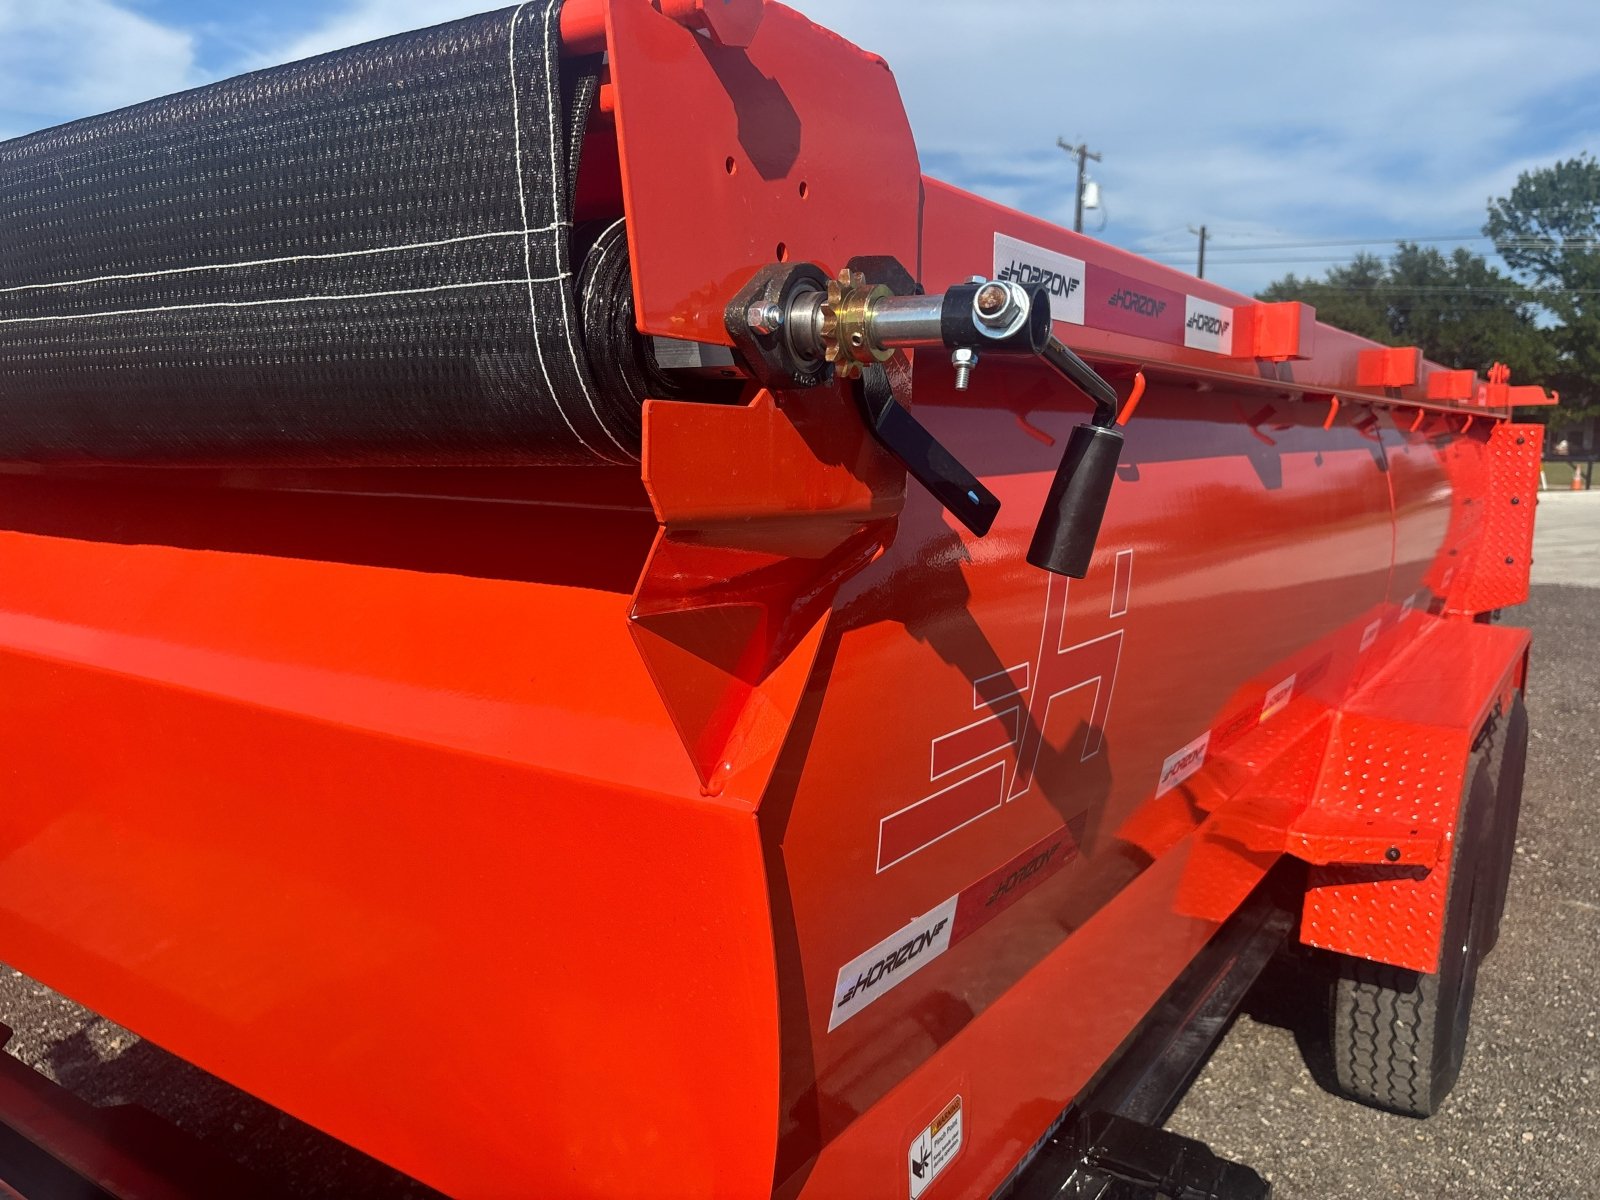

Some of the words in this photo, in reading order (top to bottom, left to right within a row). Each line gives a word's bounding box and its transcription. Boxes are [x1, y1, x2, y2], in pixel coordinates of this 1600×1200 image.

[1113, 288, 1162, 318] HORIZON
[1190, 312, 1226, 336] HORIZON
[846, 921, 942, 1002] HORIZON
[936, 1100, 960, 1128] WARNING
[934, 1131, 947, 1148] Pinch
